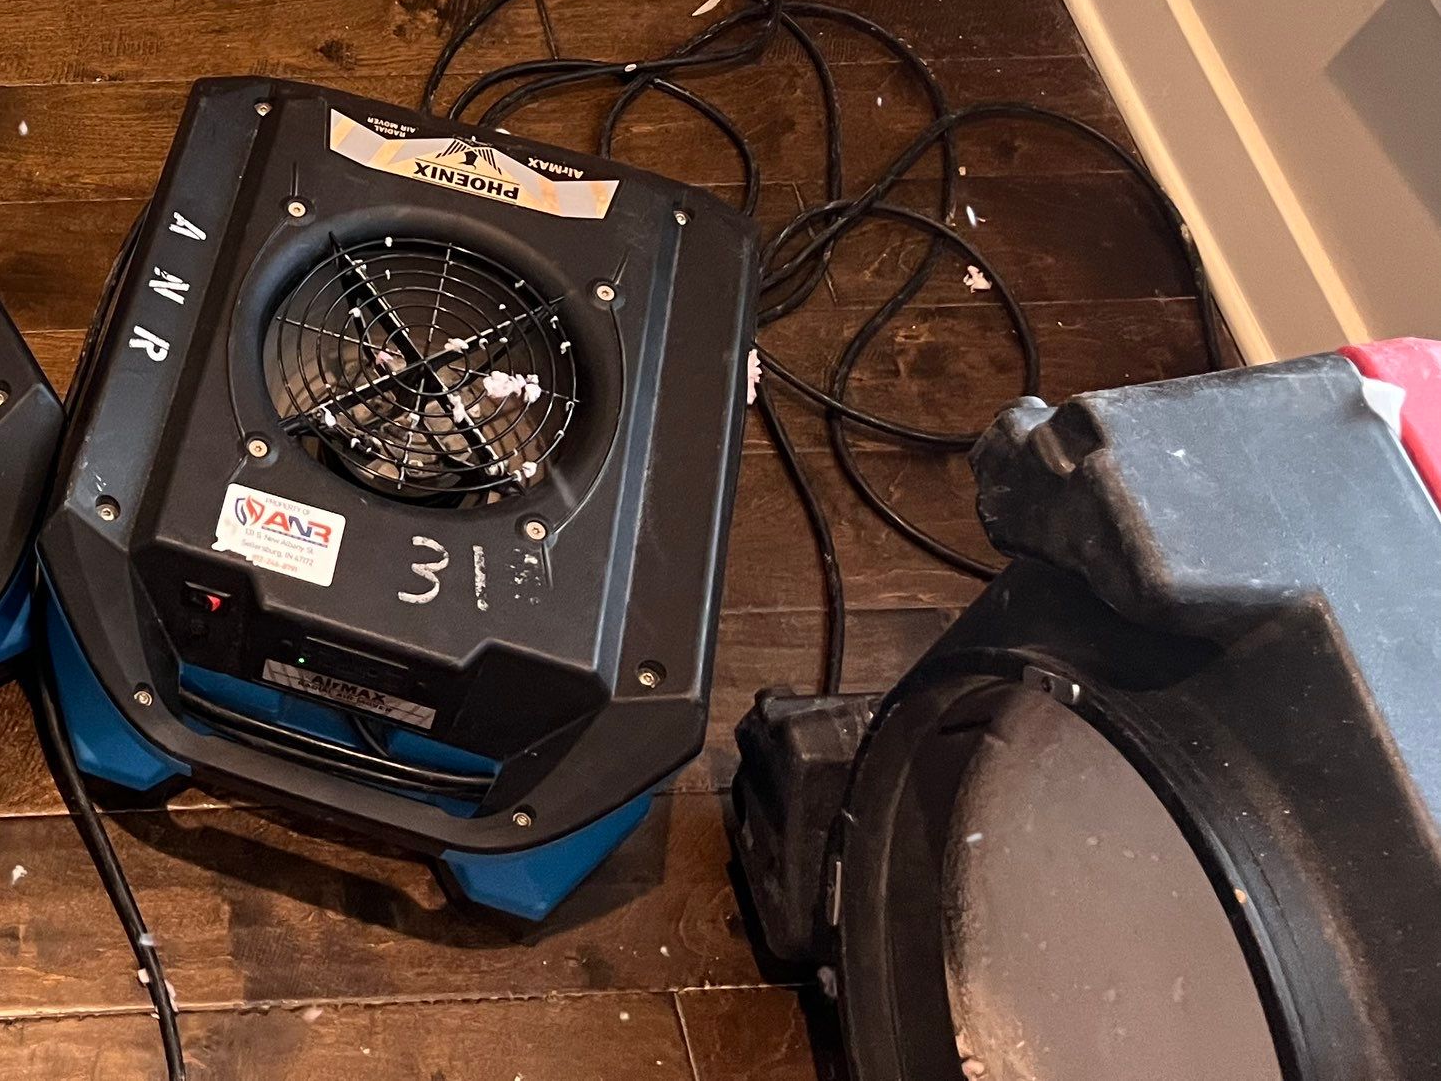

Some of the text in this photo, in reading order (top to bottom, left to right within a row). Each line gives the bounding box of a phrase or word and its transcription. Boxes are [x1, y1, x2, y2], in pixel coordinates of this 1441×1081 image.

[367, 115, 417, 134] AIR MOVER
[374, 124, 406, 138] RADIAL
[413, 161, 520, 201] PHOENIX
[262, 510, 333, 544] ANR
[264, 533, 280, 545] New
[281, 538, 305, 554] Albany
